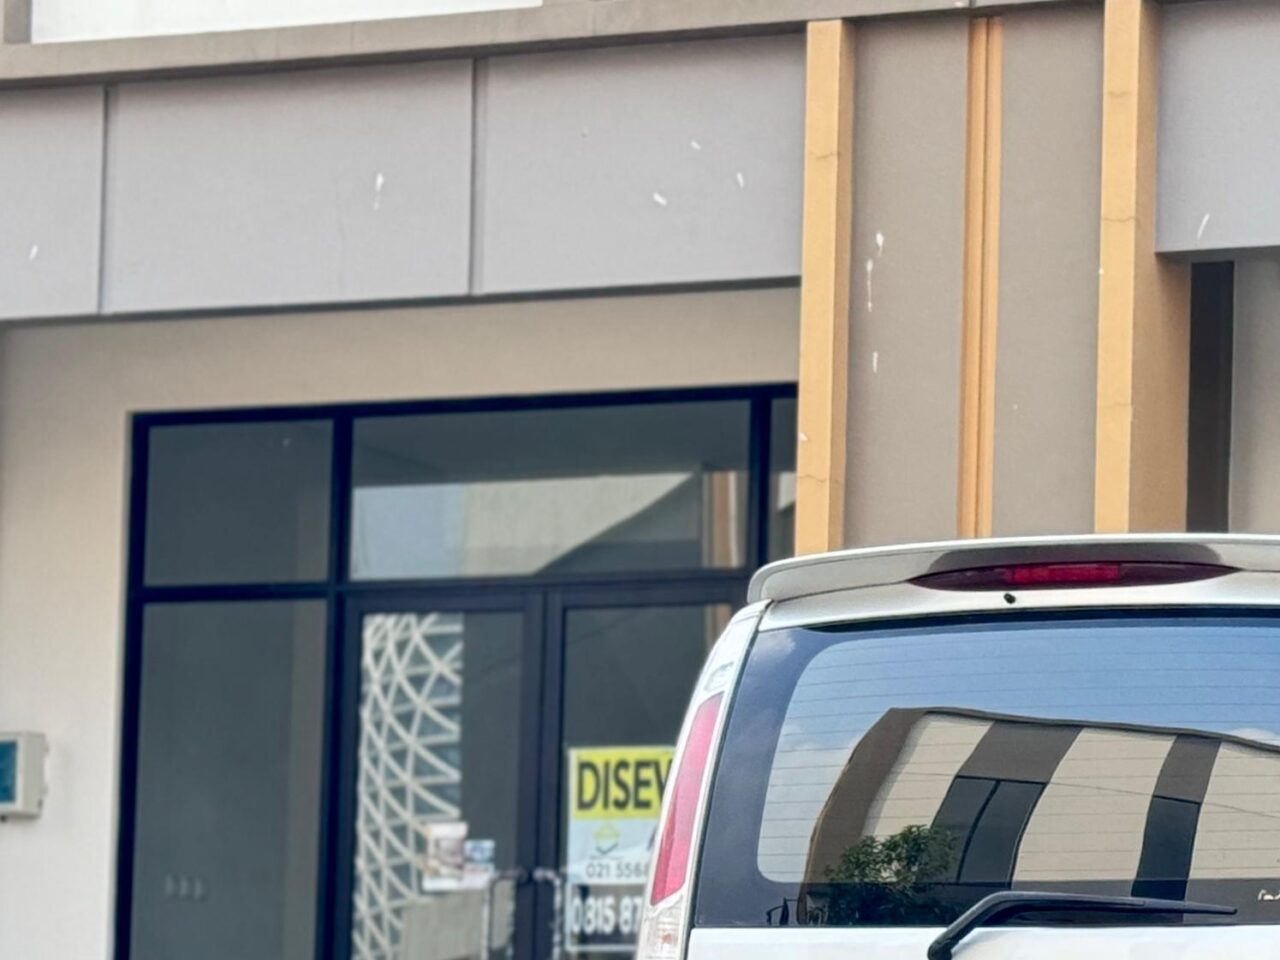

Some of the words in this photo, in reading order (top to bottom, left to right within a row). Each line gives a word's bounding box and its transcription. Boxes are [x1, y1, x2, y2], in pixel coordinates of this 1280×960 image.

[576, 760, 673, 811] DISE
[585, 862, 610, 879] 021
[572, 896, 616, 935] 0815
[620, 896, 643, 935] 87
